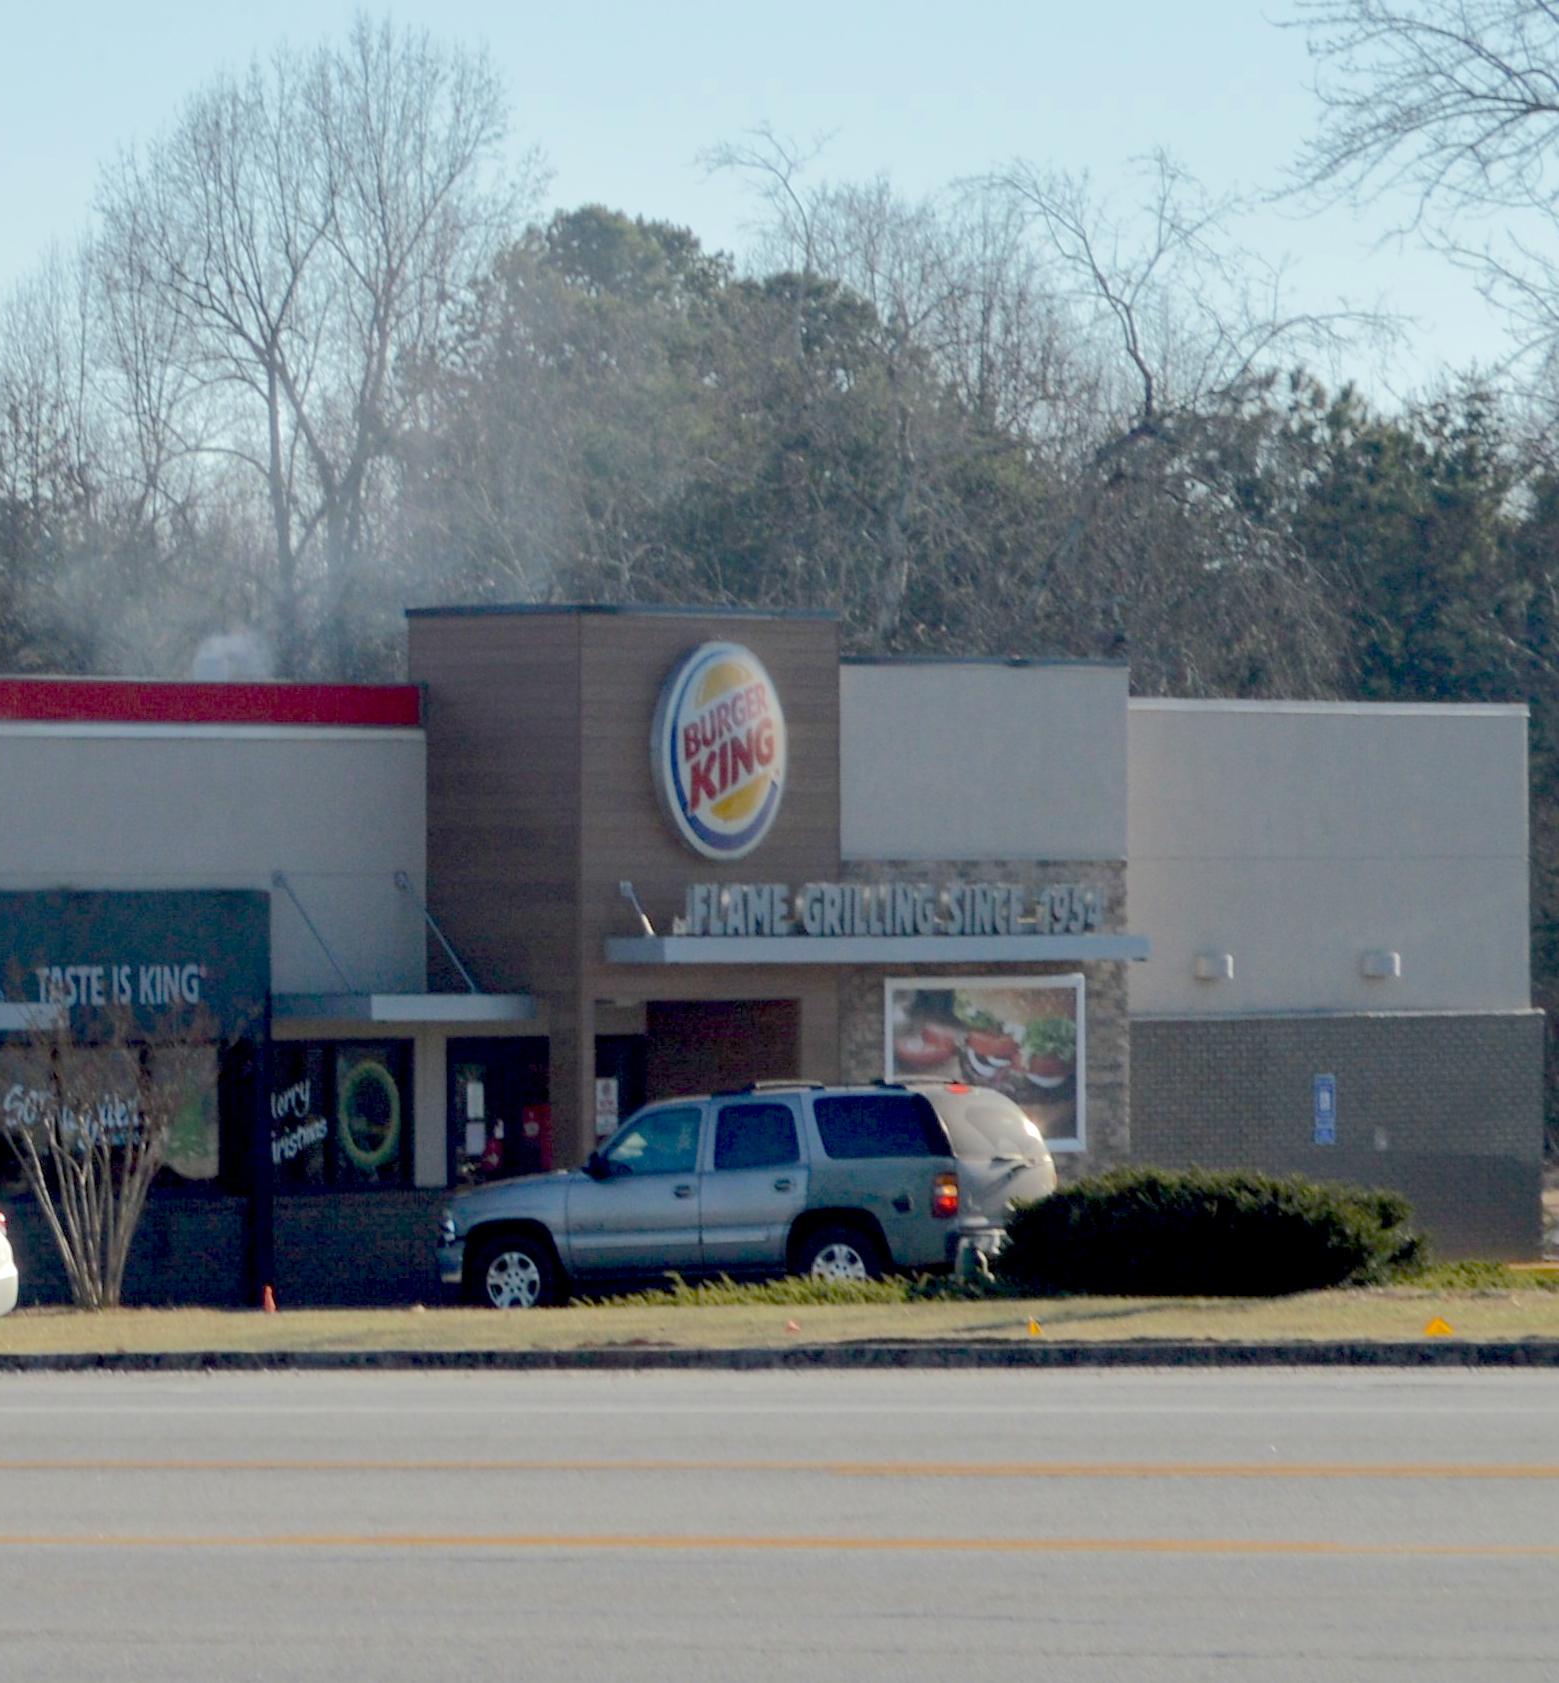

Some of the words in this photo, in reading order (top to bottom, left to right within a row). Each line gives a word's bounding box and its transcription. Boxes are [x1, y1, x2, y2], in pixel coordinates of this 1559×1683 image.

[683, 682, 769, 762] BURGER
[690, 717, 775, 813] KING
[686, 883, 790, 936] FLAME
[801, 882, 936, 937] GRILLING
[945, 882, 1026, 937] SINCE
[36, 964, 106, 1008] TASTE
[111, 964, 133, 1008] IS
[140, 963, 200, 1007] KING
